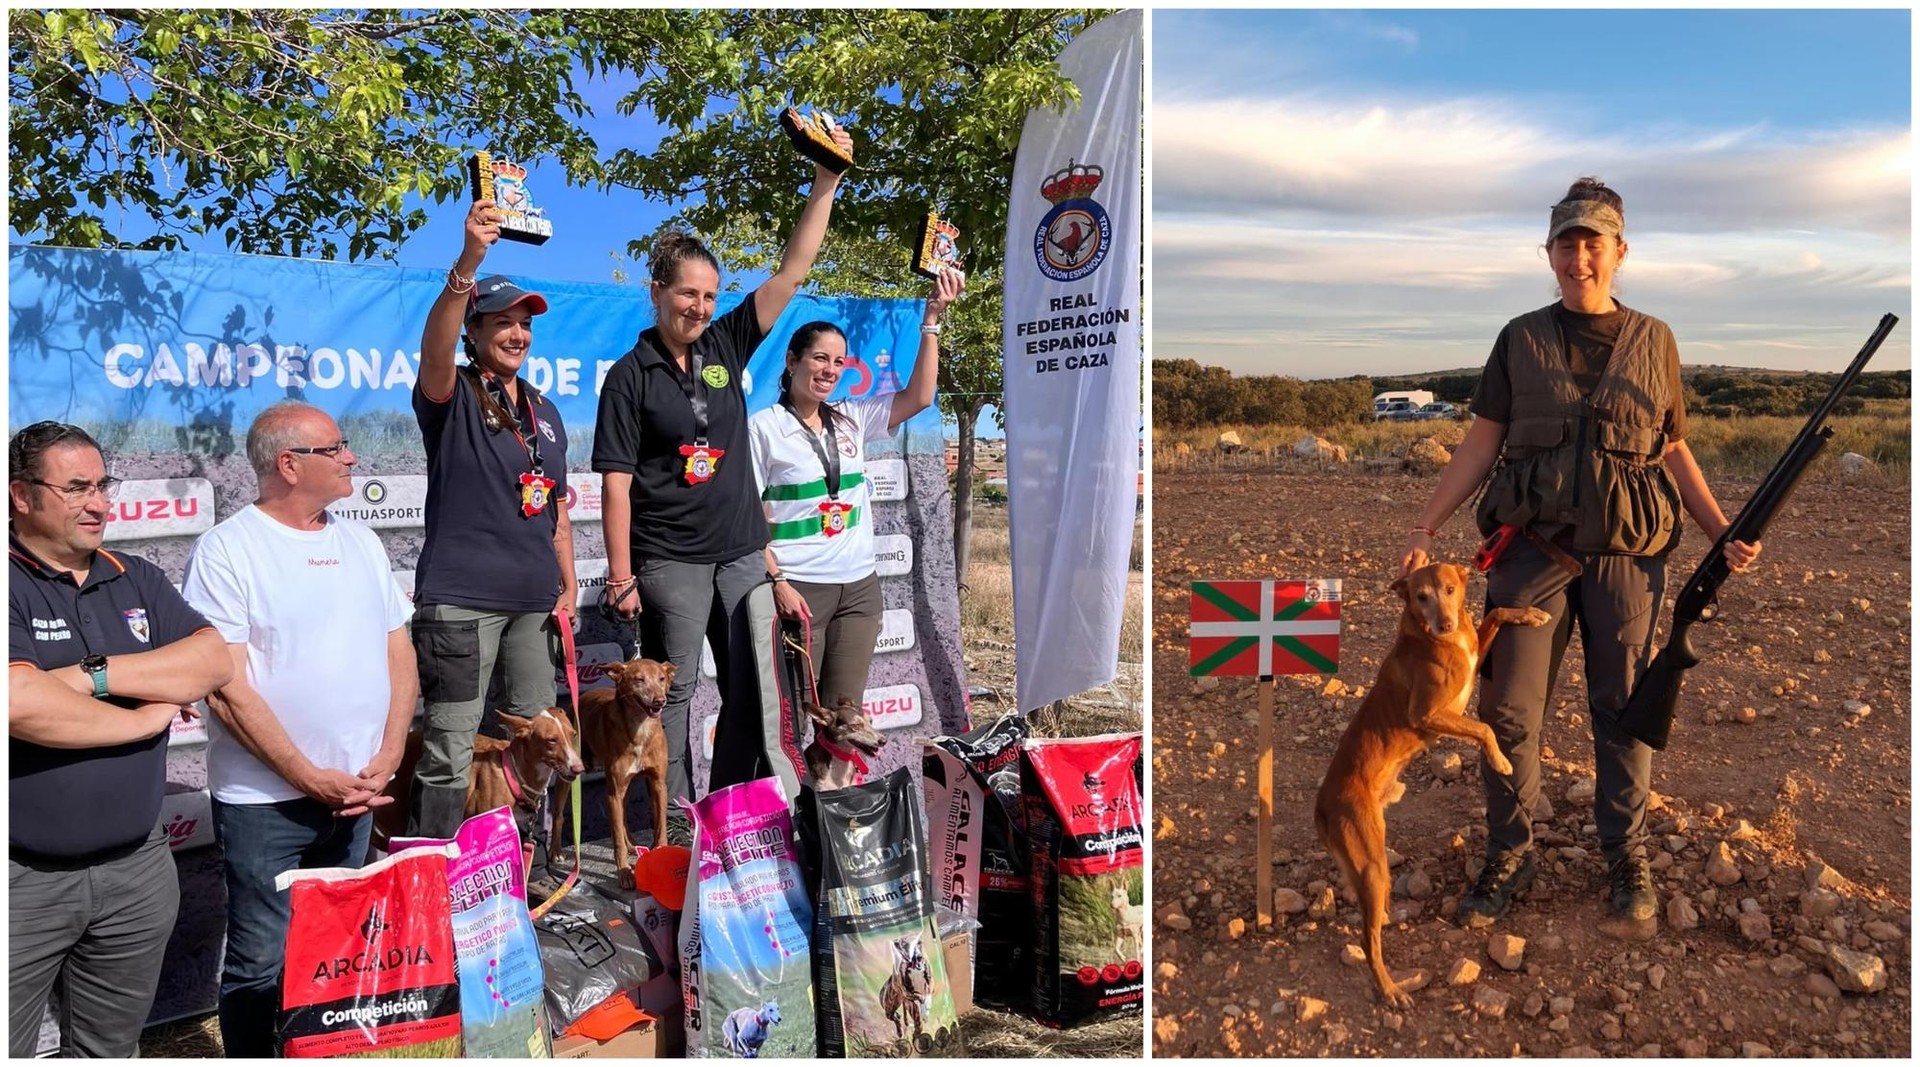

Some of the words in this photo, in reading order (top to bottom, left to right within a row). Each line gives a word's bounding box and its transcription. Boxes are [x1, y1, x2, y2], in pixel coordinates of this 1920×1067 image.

[1036, 225, 1048, 247] REAL
[1099, 239, 1109, 251] DE
[1050, 293, 1097, 312] REAL
[1016, 307, 1130, 336] FEDERACIÓN
[1025, 331, 1117, 355] ESPAÑOLA
[104, 342, 464, 391] CAMPEONA
[527, 356, 581, 397] DE
[1036, 358, 1059, 374] DE
[1065, 353, 1109, 371] CAZA
[332, 507, 422, 520] UTUASPORT
[862, 696, 912, 716] SUZU
[951, 789, 971, 913] GALACE
[311, 945, 434, 983] ARCADIA
[321, 995, 428, 1026] Competición
